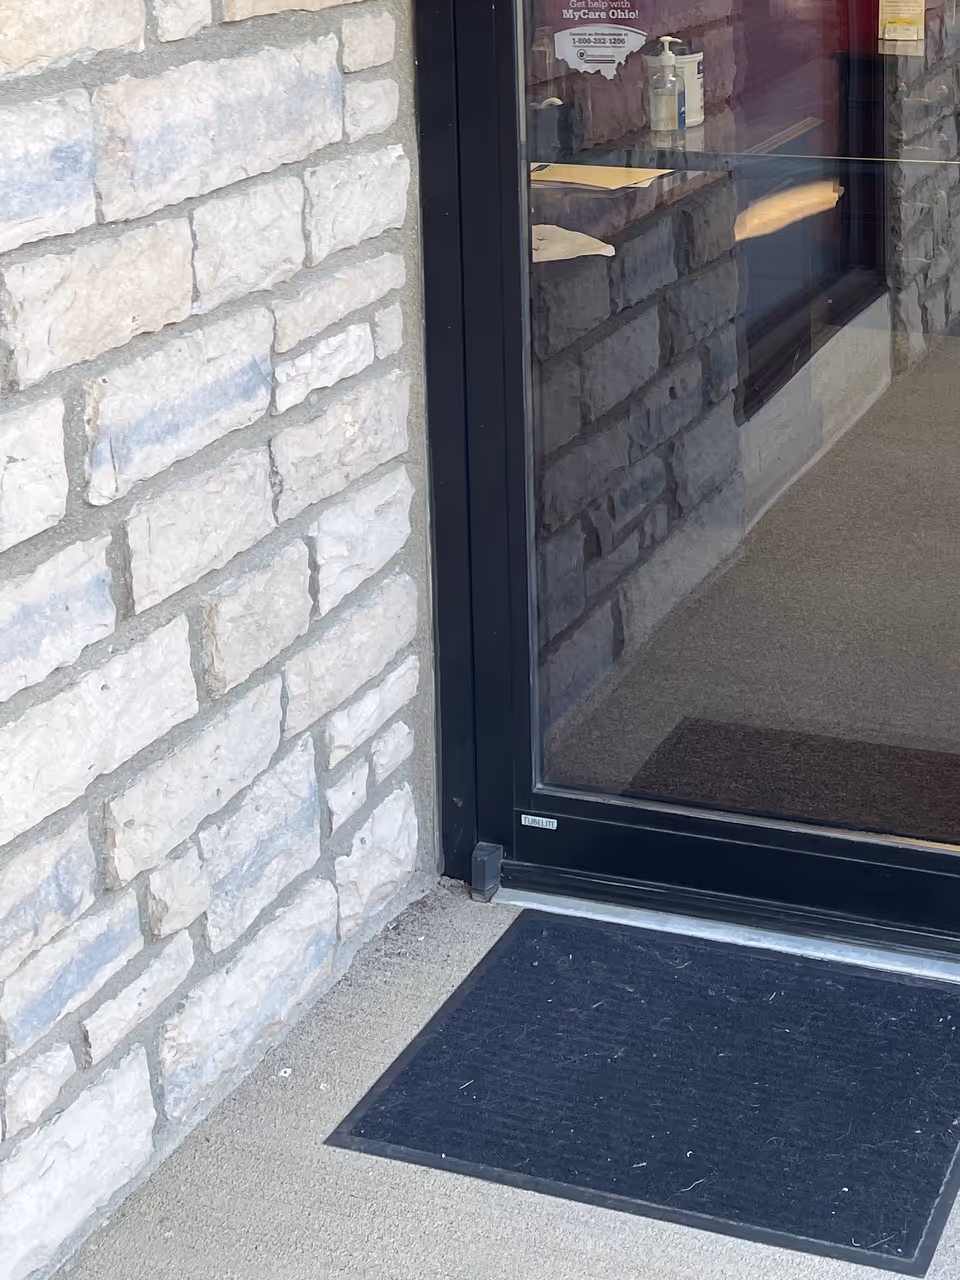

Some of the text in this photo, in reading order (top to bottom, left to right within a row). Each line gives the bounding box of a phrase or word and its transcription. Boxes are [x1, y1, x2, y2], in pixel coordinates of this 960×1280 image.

[569, 0, 630, 10] Get help with
[562, 9, 639, 20] MyCare Ohio!
[523, 816, 556, 828] TUBELITE
